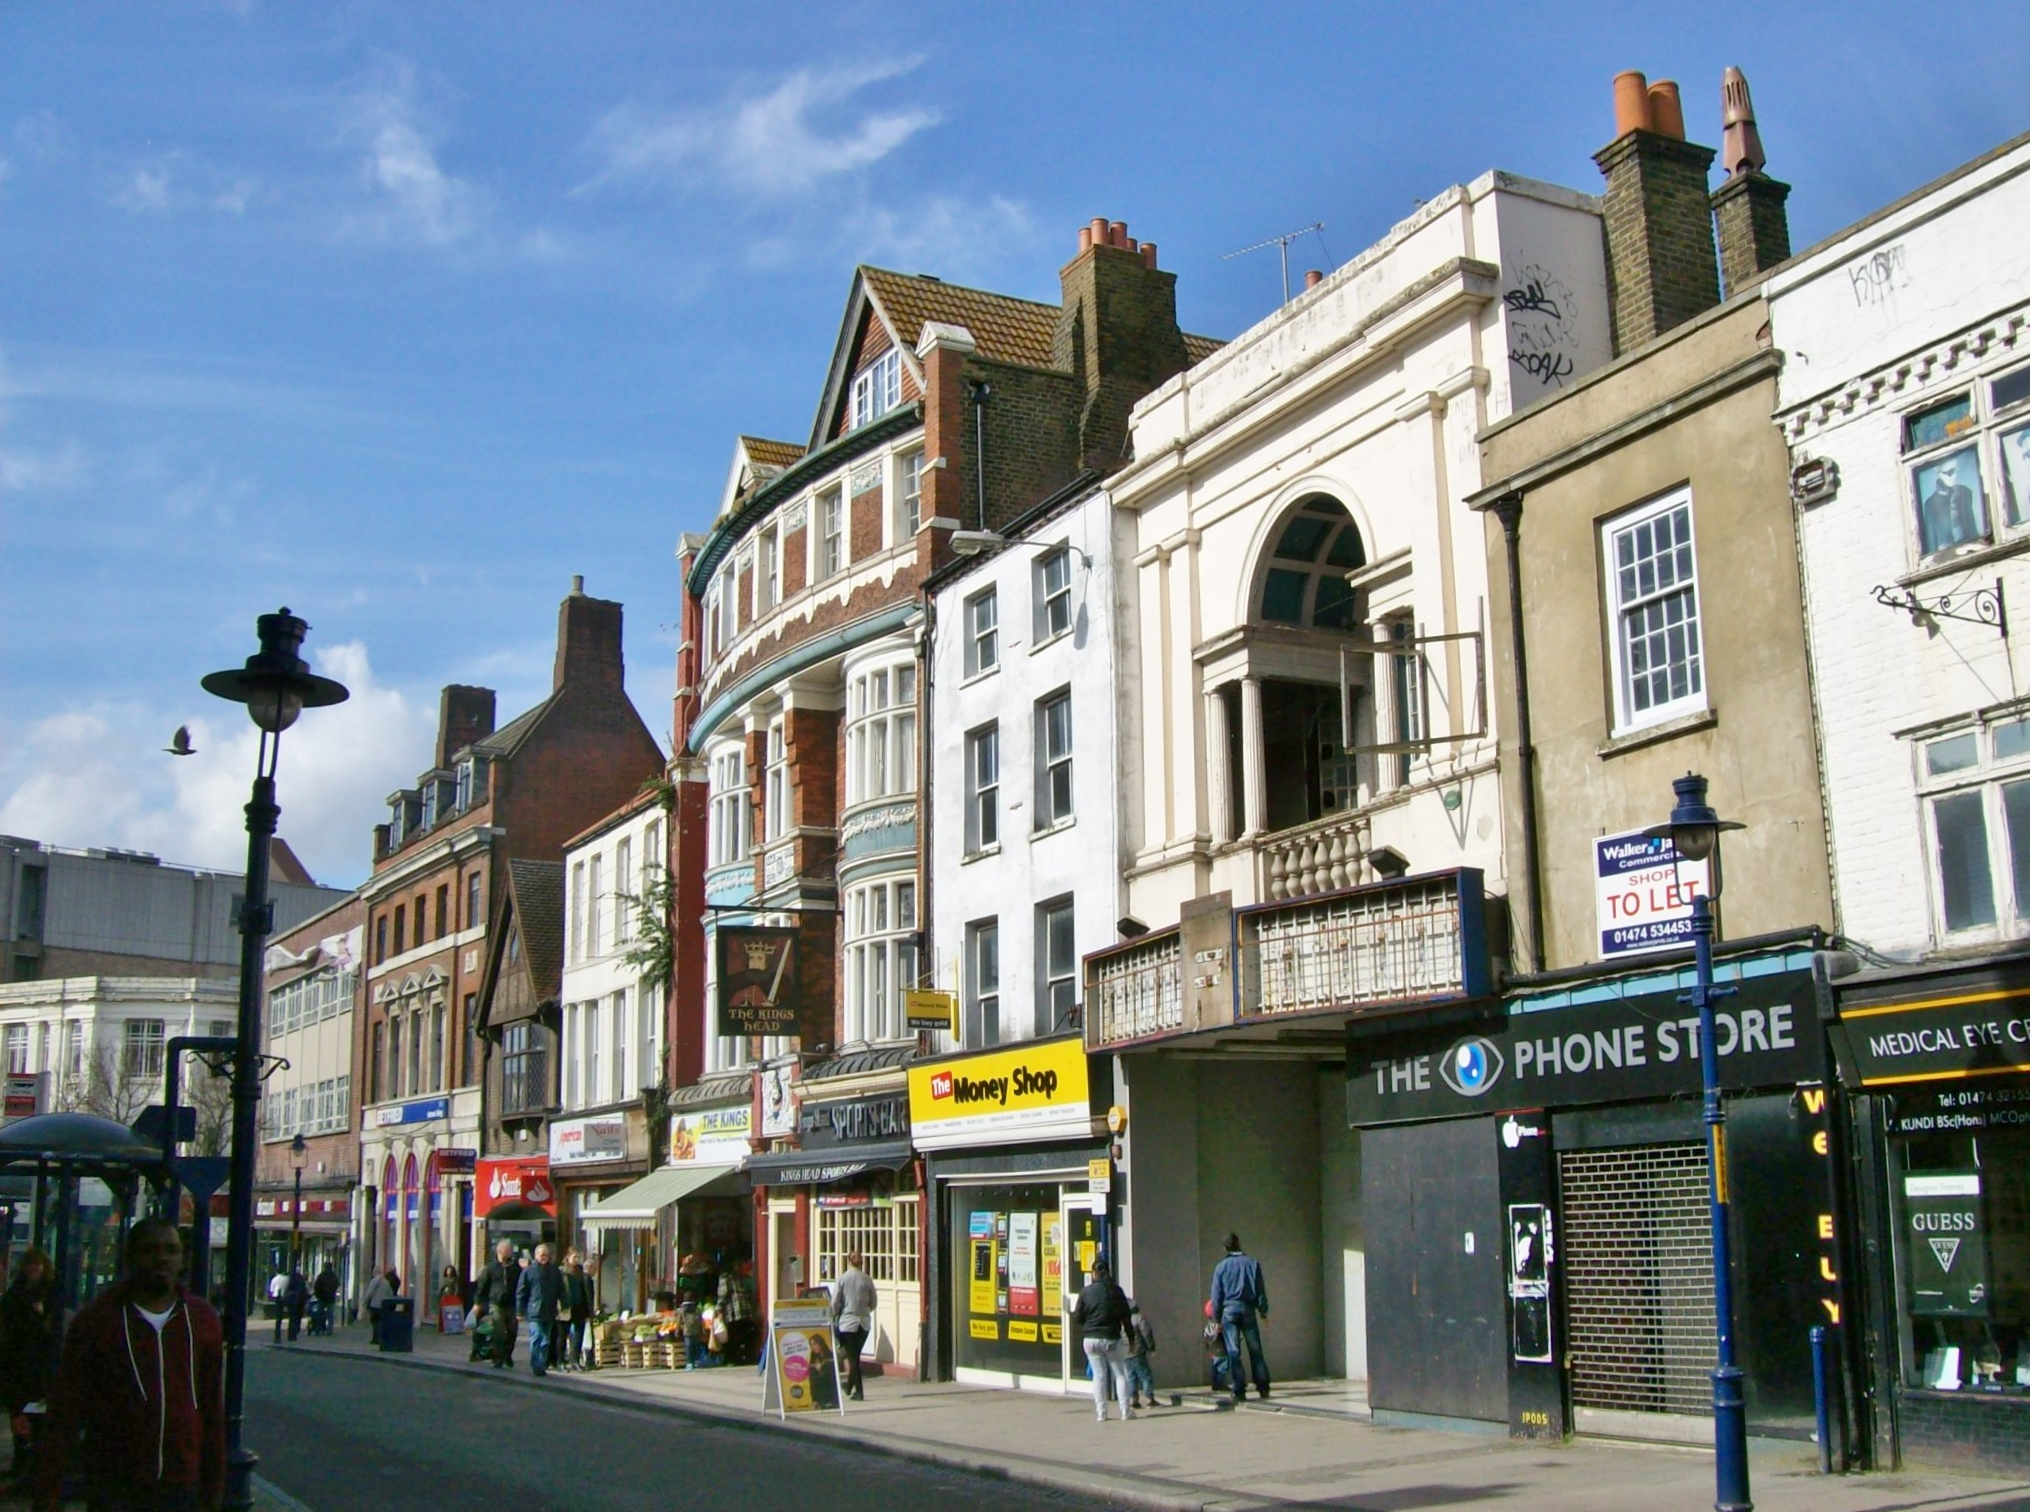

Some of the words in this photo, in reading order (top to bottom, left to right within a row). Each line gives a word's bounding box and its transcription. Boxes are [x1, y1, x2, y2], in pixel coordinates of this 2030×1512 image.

[1603, 843, 1649, 861] Walker
[1628, 868, 1675, 886] SHOP
[1607, 891, 1640, 919] TO
[1650, 880, 1700, 913] LET
[1614, 928, 1648, 944] 01474
[1650, 919, 1692, 939] 534453
[1869, 1027, 1960, 1057] MEDICAL
[1963, 1022, 2003, 1047] EYE
[1370, 1055, 1431, 1095] THE
[1514, 1025, 1646, 1079] PHONE
[1656, 1004, 1796, 1063] STORE
[932, 1079, 951, 1096] The
[954, 1077, 1008, 1106] Money
[1012, 1066, 1058, 1099] Shop
[1938, 1094, 1956, 1107] Tel:
[703, 1114, 718, 1129] THE
[720, 1110, 748, 1127] KINGS
[832, 1102, 877, 1139] SPORTS
[1901, 1116, 1935, 1131] KUNDI
[780, 1169, 801, 1182] KINGS
[802, 1168, 820, 1180] HEAD
[1912, 1213, 1975, 1231] GUESS
[1522, 1411, 1548, 1425] IPODS
